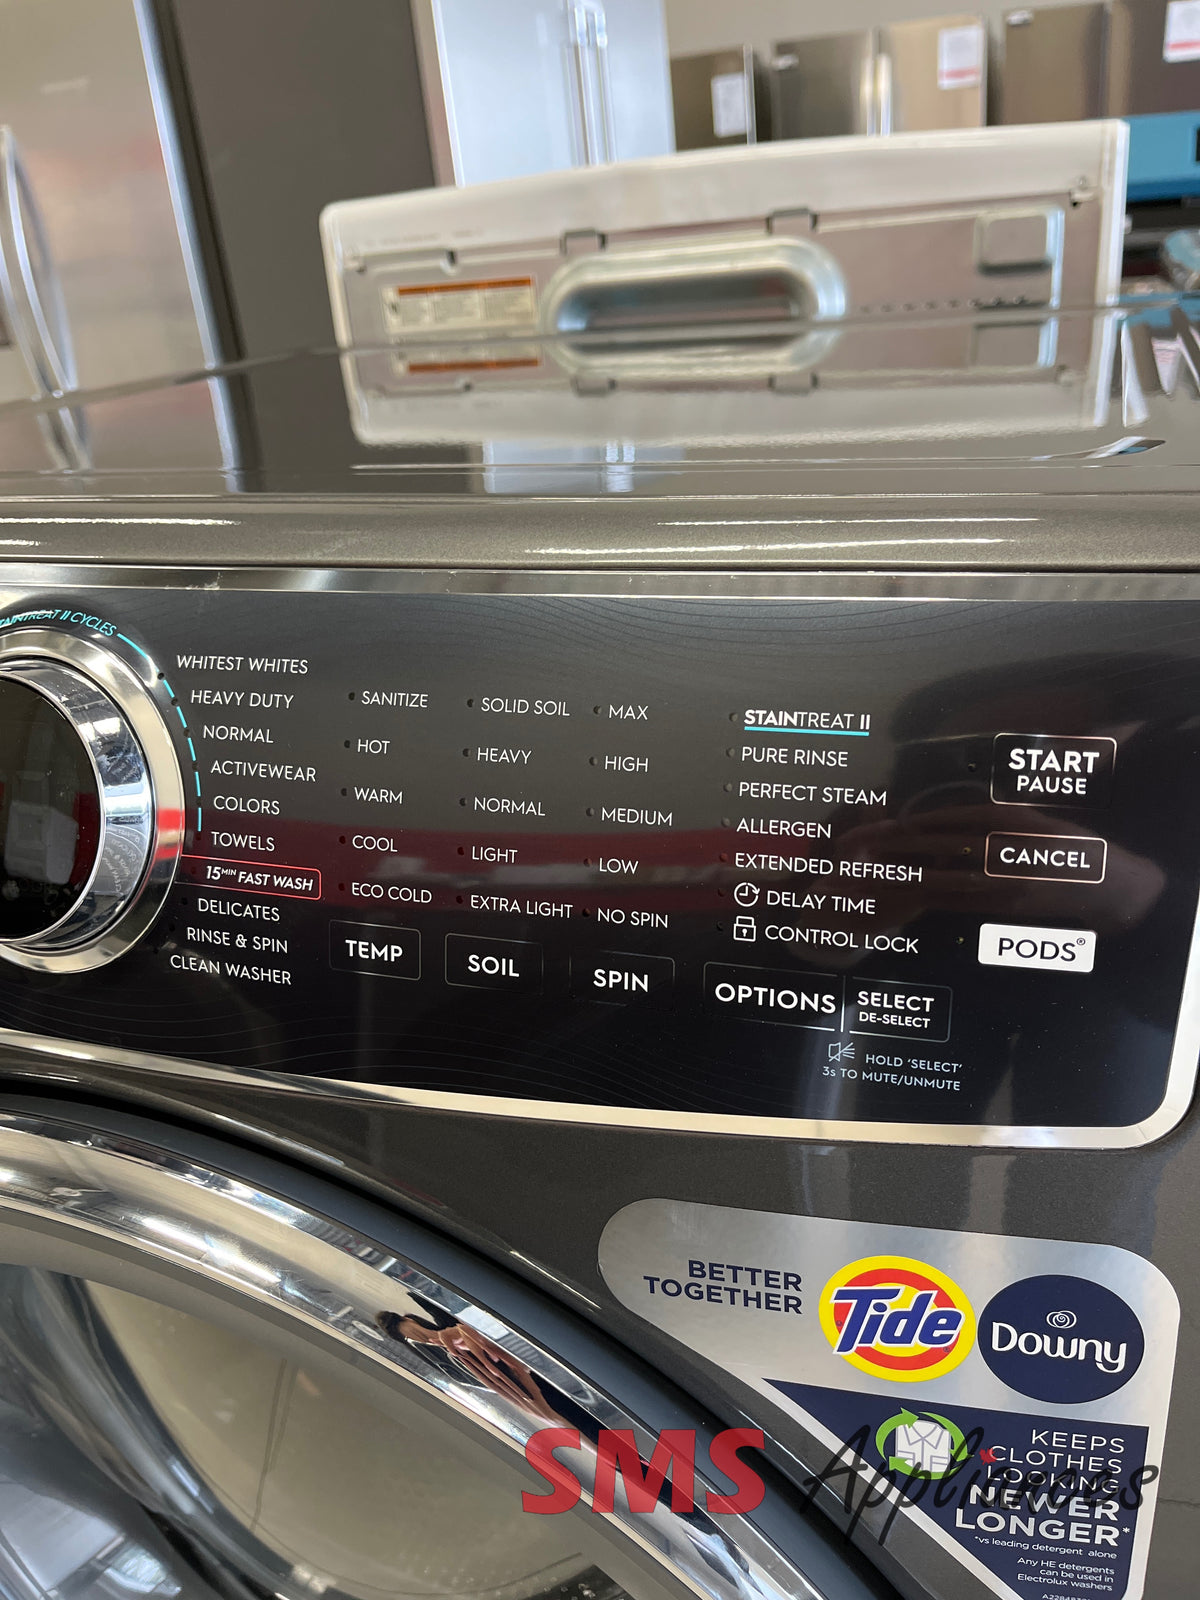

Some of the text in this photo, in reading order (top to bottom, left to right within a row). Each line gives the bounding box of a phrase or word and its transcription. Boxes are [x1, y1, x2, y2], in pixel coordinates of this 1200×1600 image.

[70, 612, 117, 637] CYCLES
[177, 655, 308, 674] WHITEST WHITES
[191, 690, 294, 709] HEAVY DUTY
[361, 691, 428, 708] SANITIZE
[481, 697, 570, 716] SOLID SOIL
[609, 705, 648, 720] MAX
[744, 709, 870, 730] STAINTREAT II
[203, 725, 274, 743] NORMAL
[357, 739, 390, 755] HOT
[477, 747, 531, 765] HEAVY
[741, 747, 848, 768] PURE RINSE
[211, 760, 316, 782] ACTIVEWEAR
[605, 756, 648, 773] HIGH
[1008, 748, 1100, 774] START
[354, 786, 403, 804] WARM
[739, 782, 887, 807] PERFECT STEAM
[1016, 775, 1087, 796] PAUSE
[213, 795, 280, 815] COLORS
[474, 797, 545, 816] NORMAL
[601, 807, 672, 826] MEDIUM
[737, 818, 832, 839] ALLERGEN
[211, 831, 275, 851] TOWELS
[352, 835, 397, 852] COOL
[472, 846, 518, 863] LIGHT
[999, 847, 1091, 869] CANCEL
[599, 857, 639, 874] LOW
[735, 853, 923, 883] EXTENDED REFRESH
[238, 871, 270, 886] FAST
[273, 875, 313, 891] WASH
[351, 882, 432, 903] ECO COLD
[767, 890, 876, 914] DELAY TIME
[198, 898, 280, 921] DELICATES
[471, 895, 573, 918] EXTRA LIGHT
[597, 907, 668, 928] NO SPIN
[187, 927, 288, 953] RINSE & SPIN
[765, 925, 919, 954] CONTROL LOCK
[345, 939, 403, 962] TEMP
[170, 955, 291, 985] CLEAN WASHER
[468, 955, 519, 978] SOIL
[593, 969, 648, 992] SPIN
[715, 982, 836, 1013] OPTIONS
[857, 991, 934, 1012] SELECT
[859, 1012, 930, 1029] DE-SELECT
[866, 1053, 903, 1067] HOLD
[822, 1066, 961, 1091] 3s TO MUTE/UNMUTE
[688, 1259, 801, 1293] BETTER
[643, 1274, 802, 1315] TOGETHER
[831, 1286, 965, 1354] Tide
[991, 1321, 1127, 1374] Downy
[1031, 1429, 1125, 1453] KEEPS
[990, 1445, 1122, 1474] CLOTHES
[987, 1465, 1119, 1494] LOOKING
[969, 1484, 1120, 1521] NEWER
[992, 1538, 1029, 1550] leading
[1031, 1543, 1083, 1556] detergent
[1088, 1550, 1117, 1559] alone
[1017, 1557, 1115, 1575] Any HE detergents
[1061, 1570, 1074, 1579] be
[1077, 1573, 1102, 1582] used
[1017, 1573, 1113, 1591] Electrolux washers
